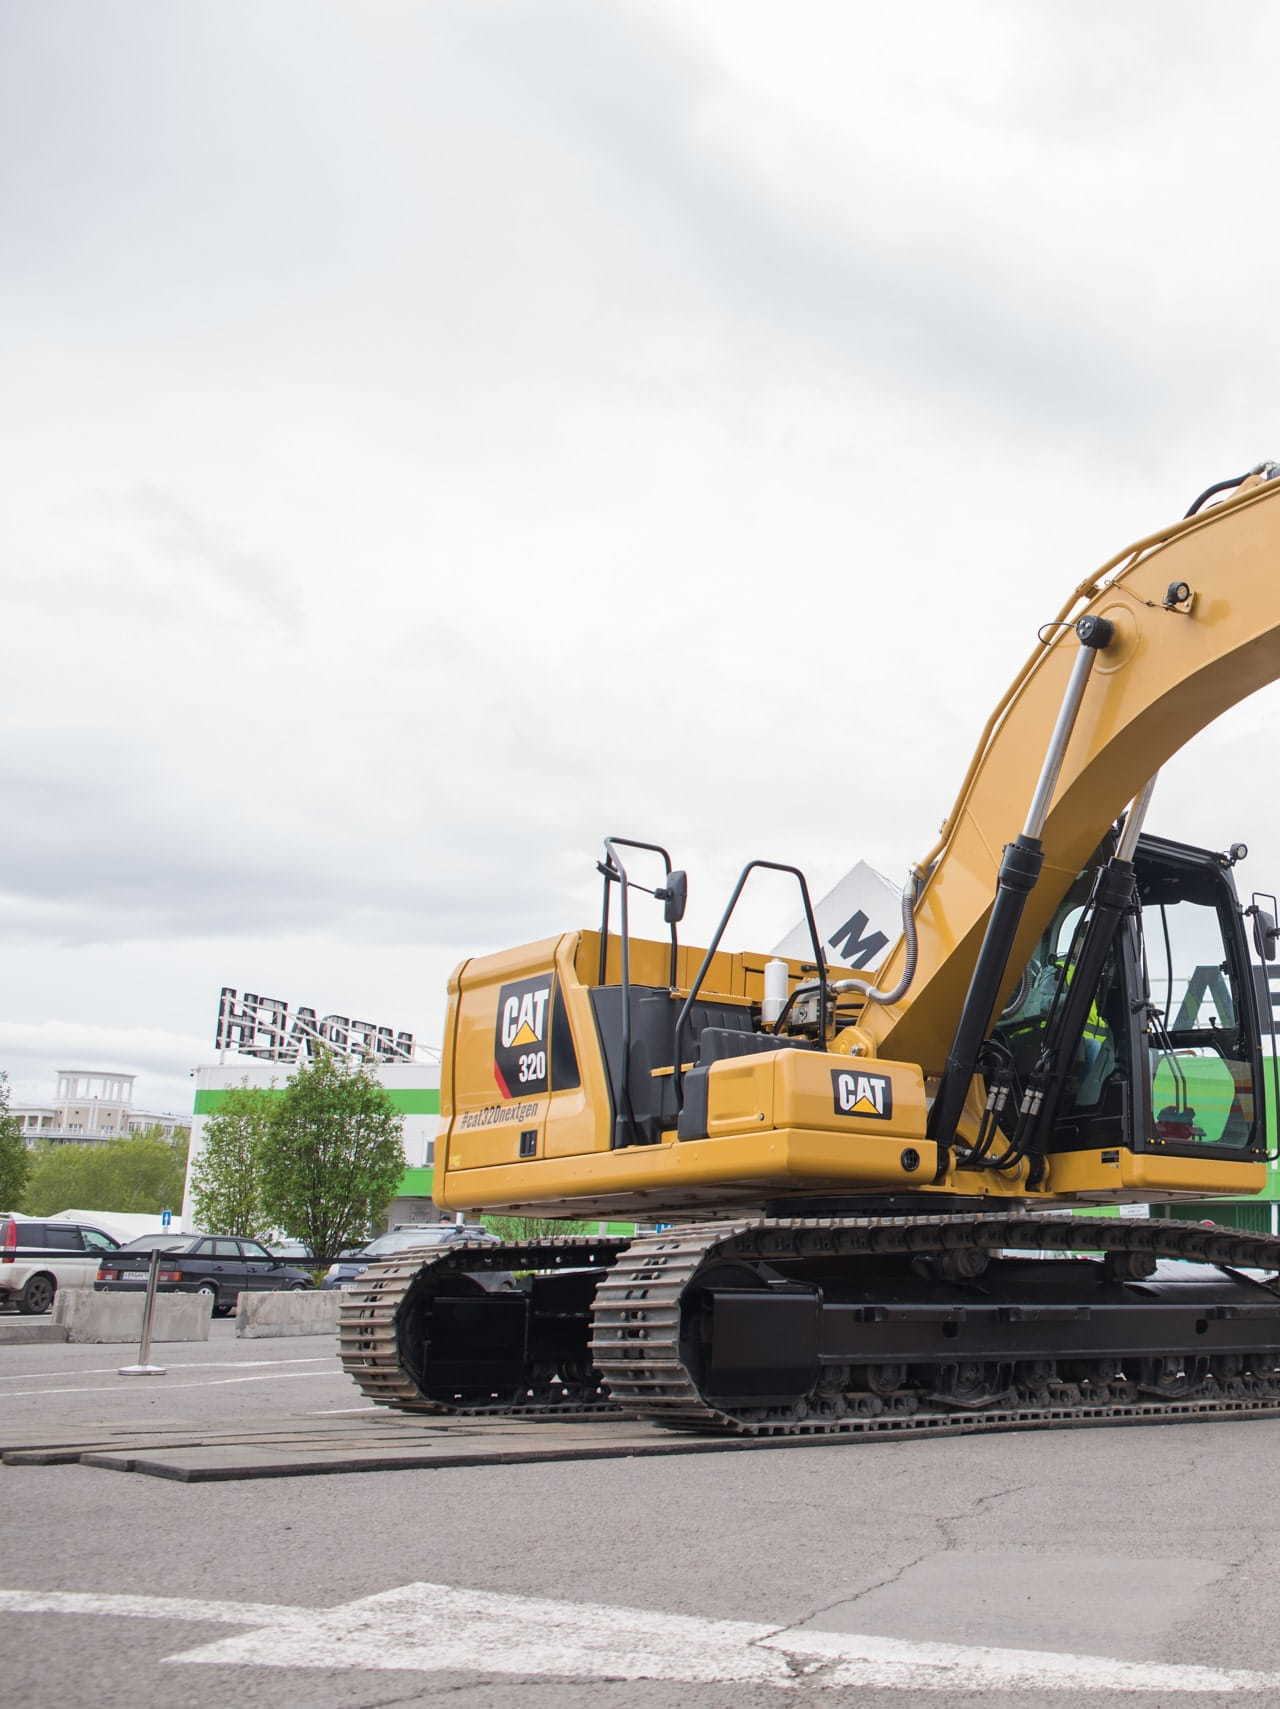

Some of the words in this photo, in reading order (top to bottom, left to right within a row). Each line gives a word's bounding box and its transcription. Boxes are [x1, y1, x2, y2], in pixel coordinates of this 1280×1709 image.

[501, 988, 550, 1048] CAT
[518, 1051, 546, 1083] 320
[838, 1073, 886, 1114] CAT
